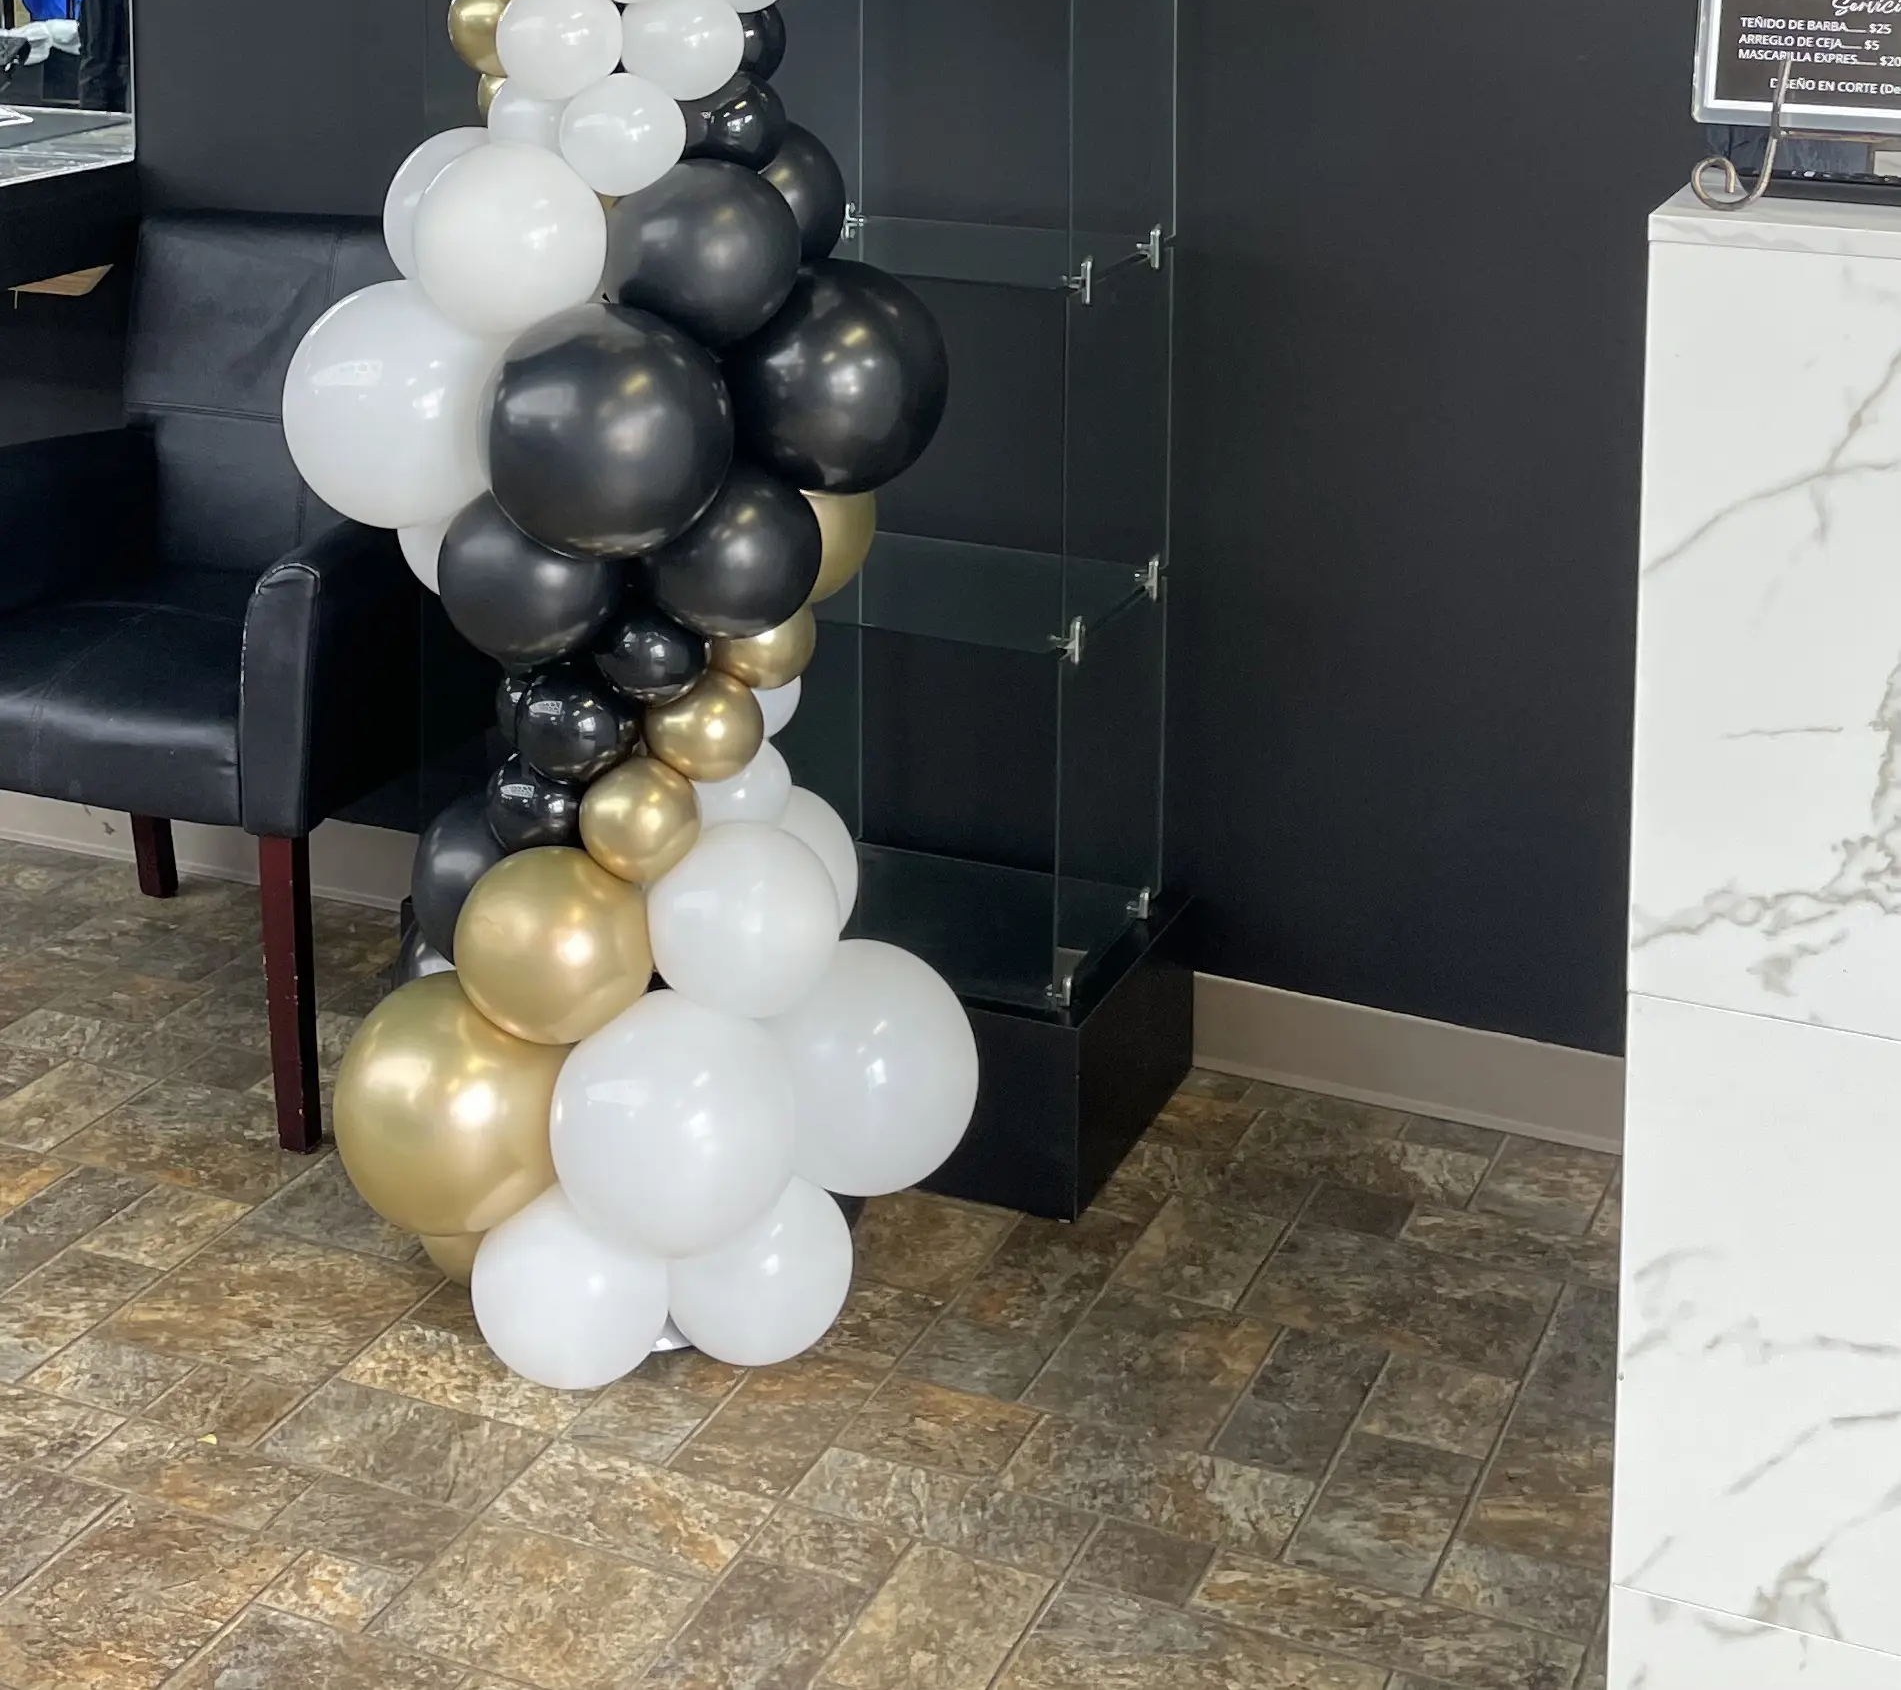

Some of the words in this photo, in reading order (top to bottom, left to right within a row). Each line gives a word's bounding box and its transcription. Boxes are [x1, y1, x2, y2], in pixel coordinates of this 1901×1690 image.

[1740, 16, 1786, 29] TEÑIDO
[1788, 19, 1806, 30] DE
[1807, 20, 1847, 32] BARBA
[1869, 23, 1892, 34] $25
[1738, 34, 1795, 46] ARREGLO
[1797, 36, 1814, 47] DE
[1816, 37, 1842, 50] CEJA
[1864, 40, 1880, 51] $5
[1814, 53, 1858, 65] EXPRES
[1770, 77, 1815, 90] DEÑO
[1818, 80, 1835, 92] EN
[1837, 82, 1878, 94] CORTE
